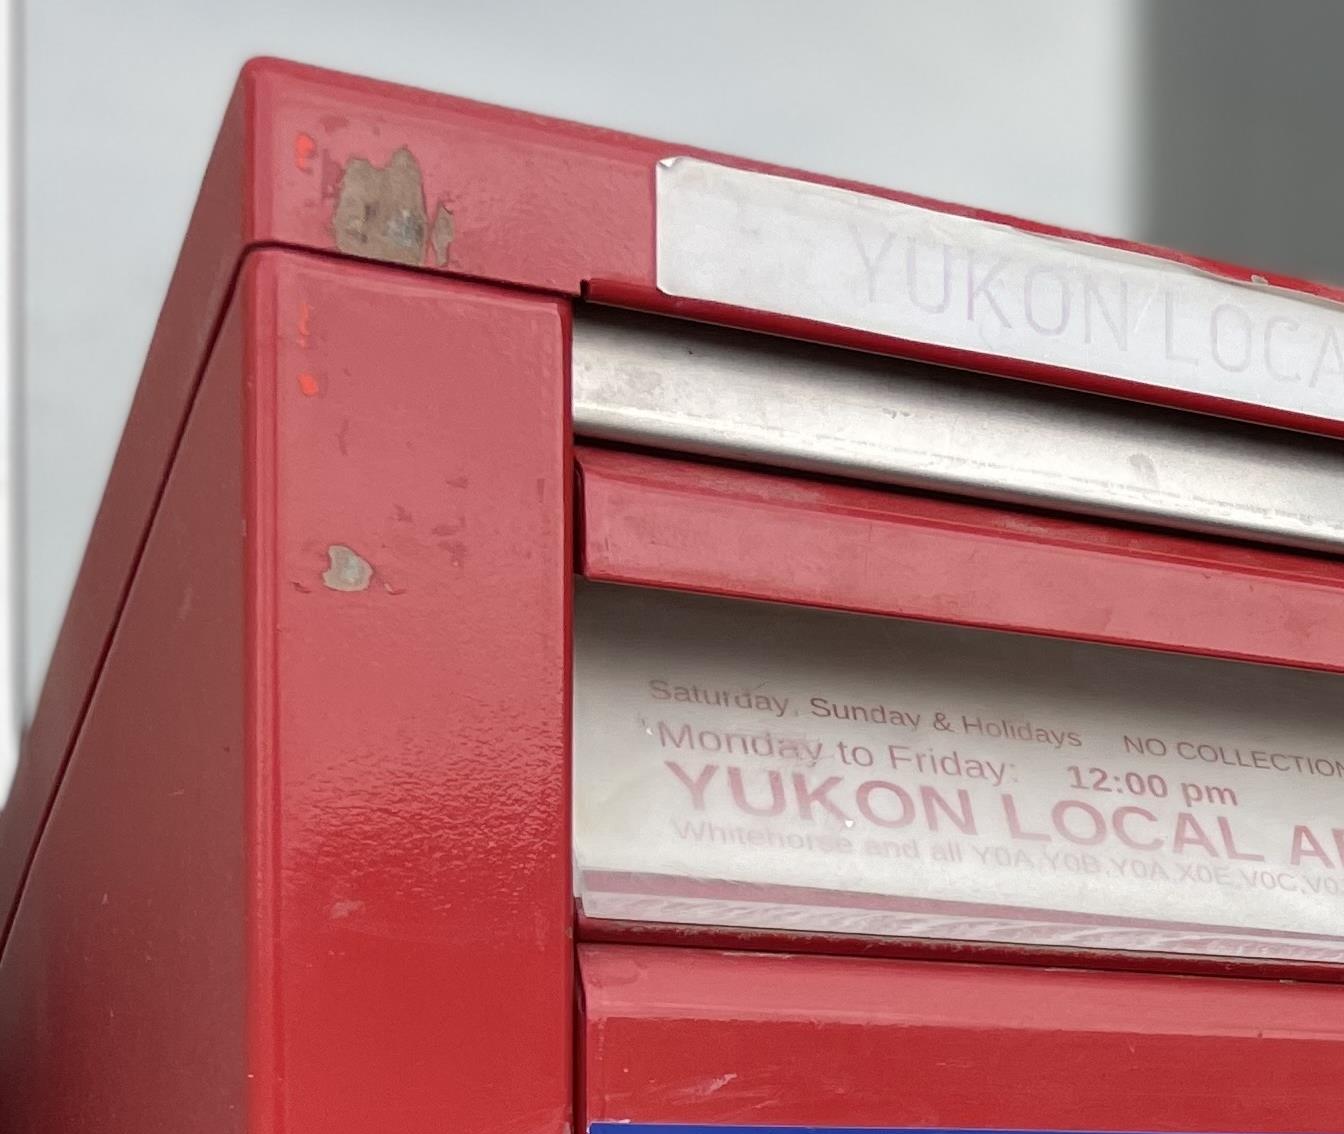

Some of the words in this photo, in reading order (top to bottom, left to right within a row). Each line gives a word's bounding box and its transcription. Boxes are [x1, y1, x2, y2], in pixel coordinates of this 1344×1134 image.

[847, 225, 1129, 352] YUKON
[657, 720, 824, 768] Monday
[838, 741, 875, 767] to
[889, 743, 1018, 786] Friday:
[1066, 765, 1169, 799] 12:00
[1181, 781, 1239, 808] pm
[809, 697, 921, 731] Sunday
[932, 711, 954, 734] &
[961, 714, 1082, 749] Holidays
[1122, 735, 1168, 757] NO
[664, 760, 979, 836] YUKON
[1001, 792, 1266, 864] LOCAL
[671, 818, 853, 854] Whitehorse
[863, 836, 921, 859] and
[930, 838, 964, 863] all
